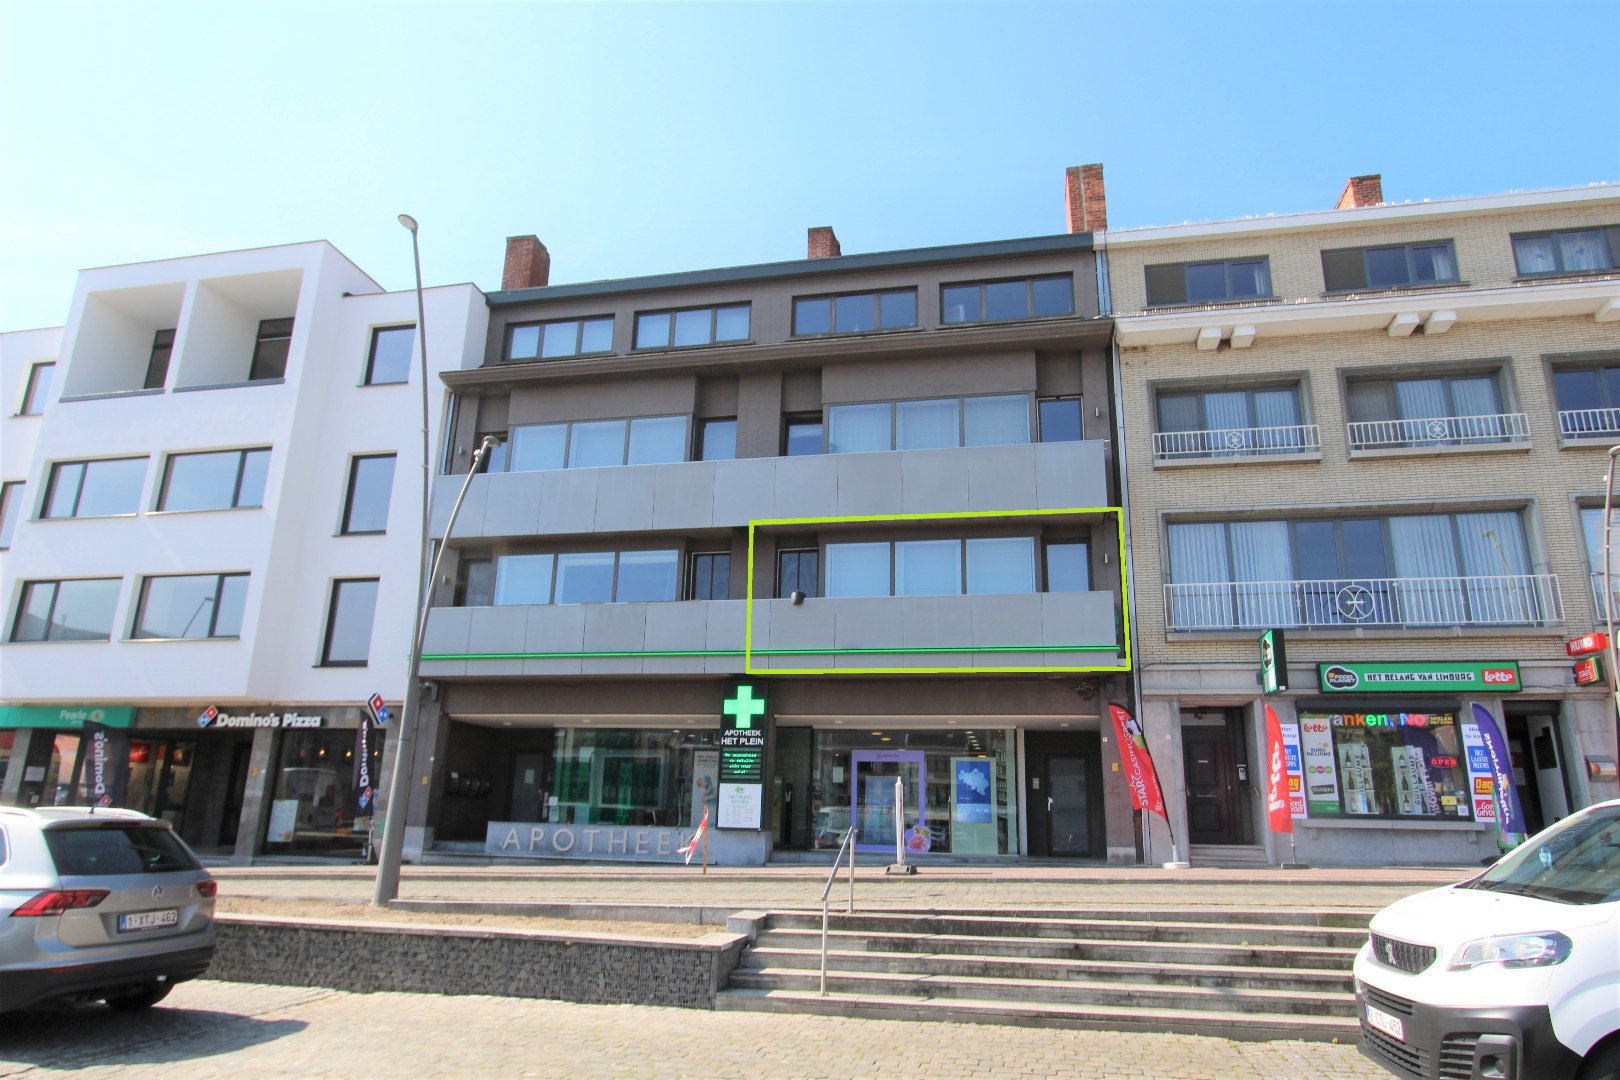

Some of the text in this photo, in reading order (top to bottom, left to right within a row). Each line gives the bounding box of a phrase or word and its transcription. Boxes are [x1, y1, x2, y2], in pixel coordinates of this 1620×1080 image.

[1570, 637, 1592, 651] HUMO
[60, 709, 87, 720] Pearle
[216, 711, 322, 727] Domino's Pizza
[724, 729, 761, 737] APOTHEEK
[721, 737, 764, 745] HET PLEIN
[1431, 757, 1457, 766] OPEN
[1288, 778, 1299, 790] ag
[1355, 755, 1366, 805] GUILLAUME
[1409, 755, 1421, 806] GUILLAUME
[1477, 807, 1494, 816] Gevo
